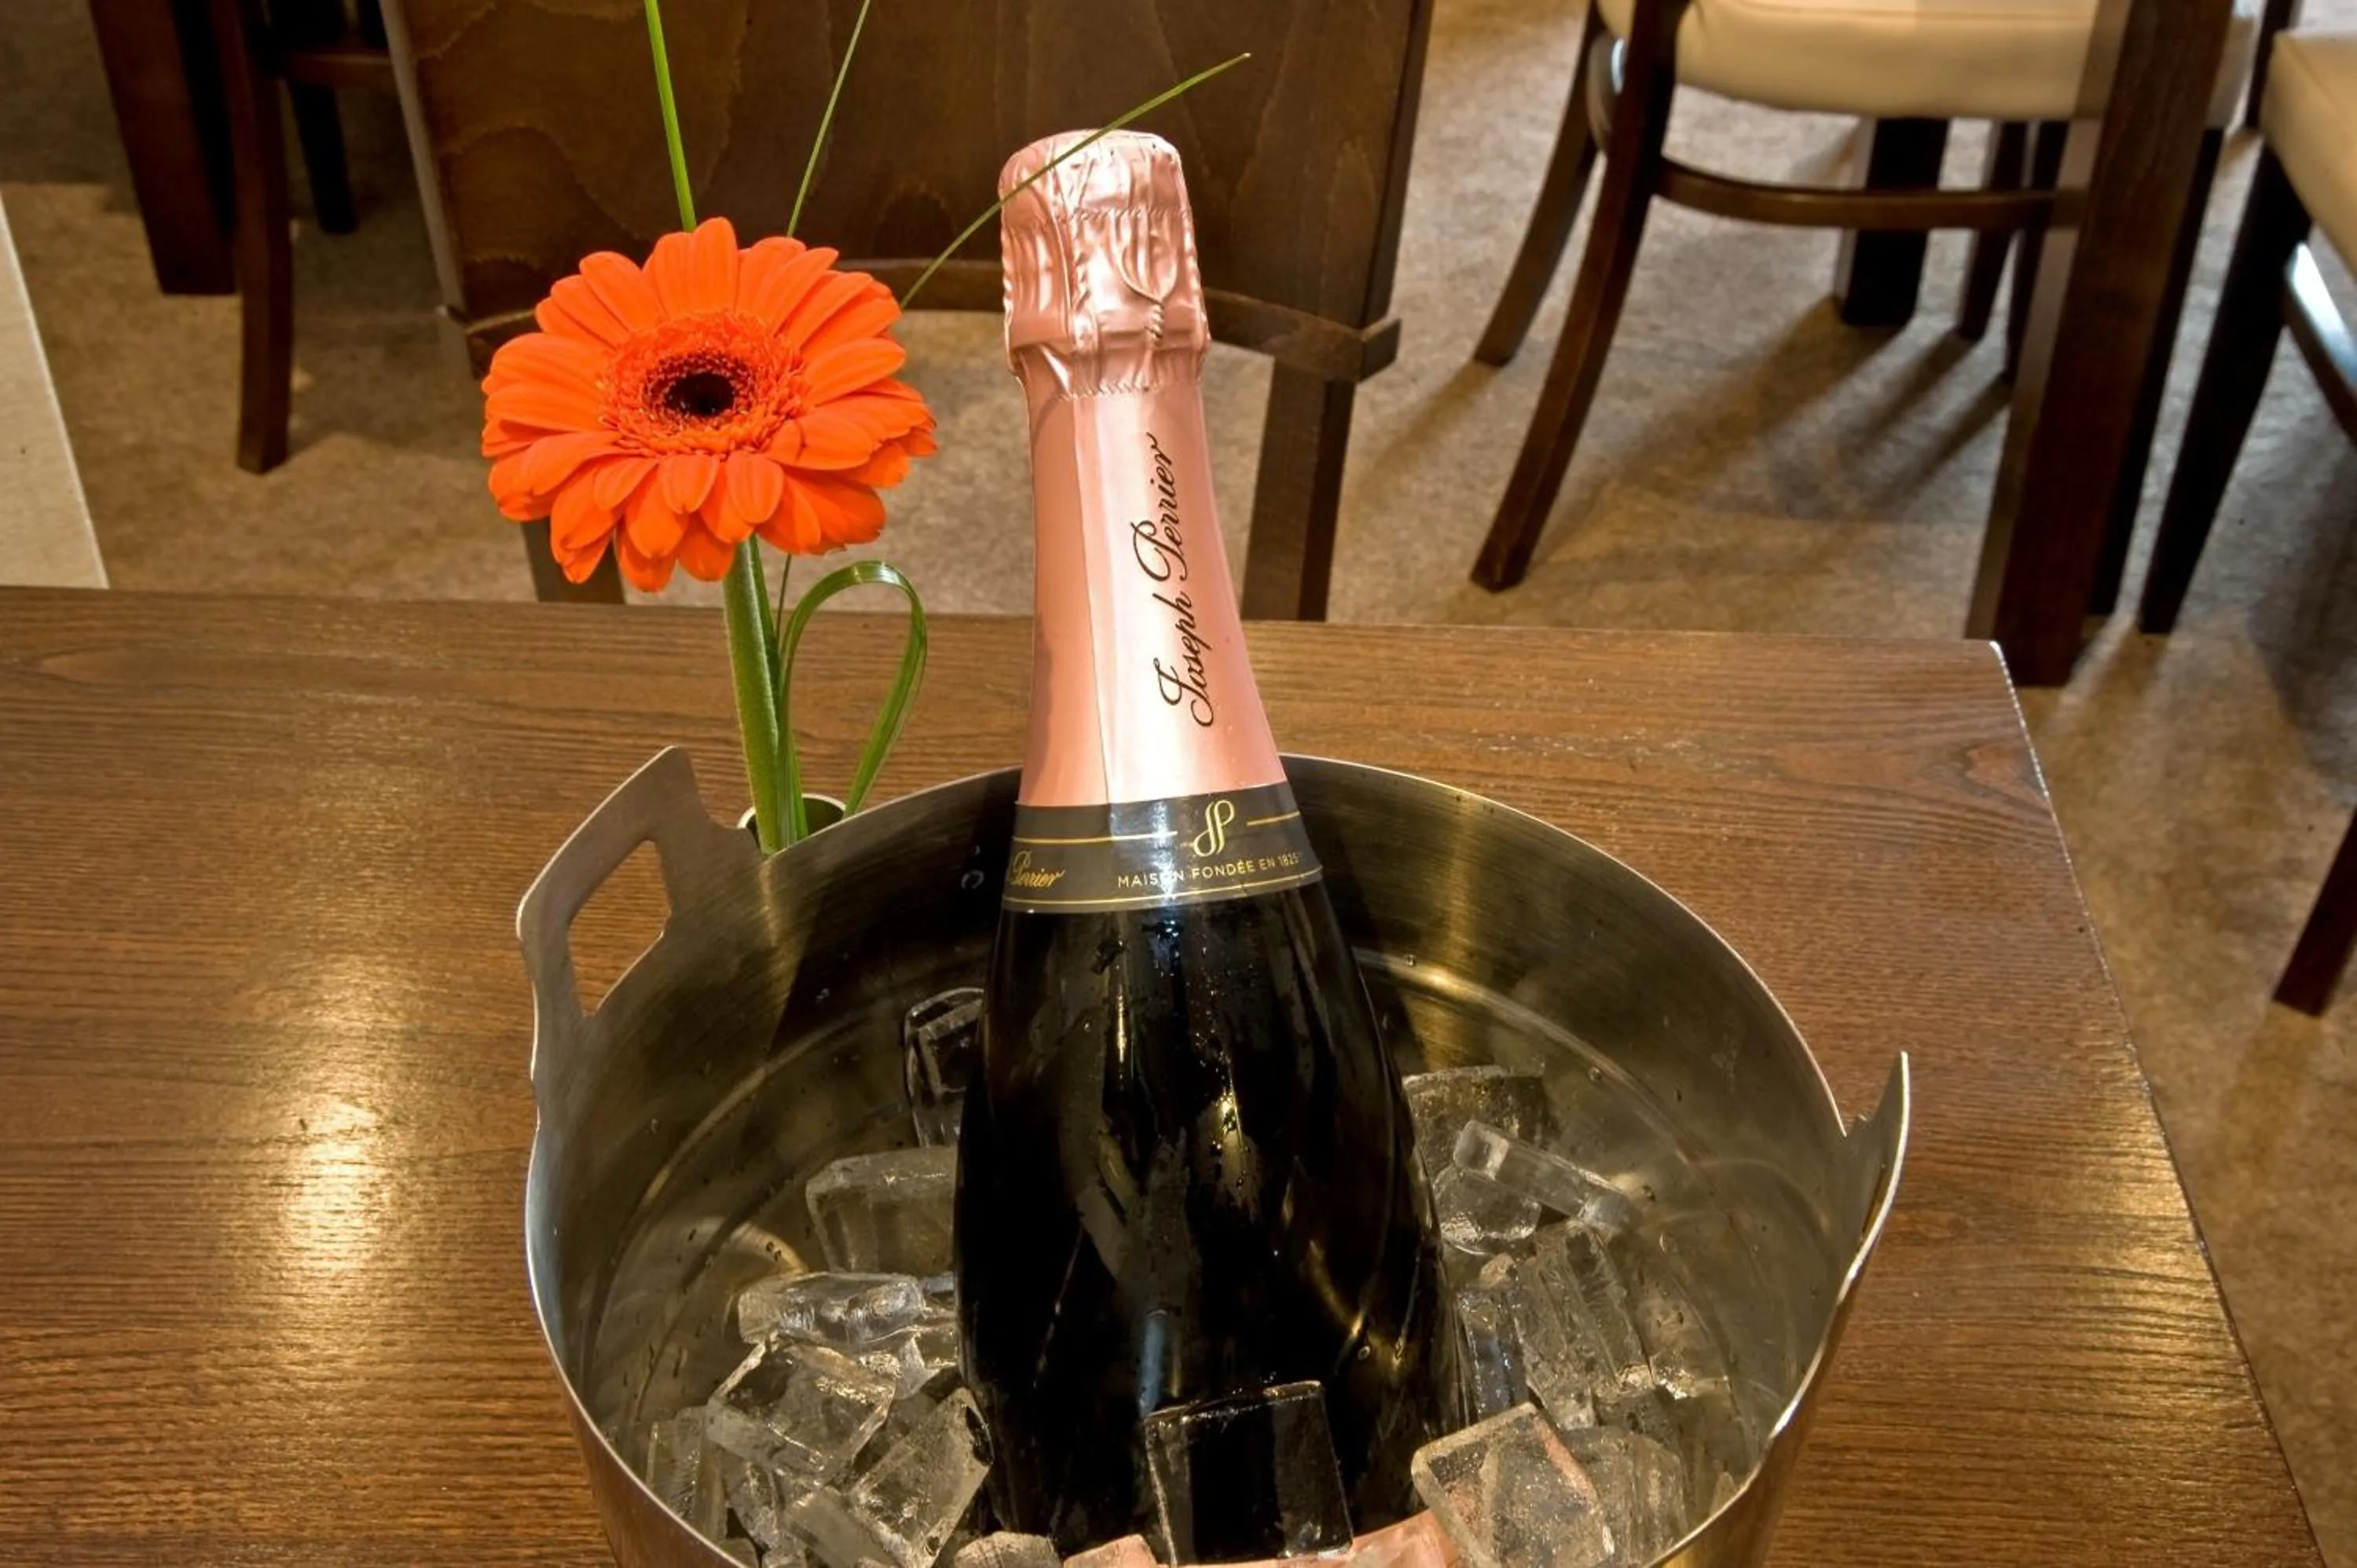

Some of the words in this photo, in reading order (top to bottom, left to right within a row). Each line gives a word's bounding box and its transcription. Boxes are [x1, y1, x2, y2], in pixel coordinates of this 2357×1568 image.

[1130, 431, 1188, 581] Perrier
[1152, 591, 1214, 727] Joseph
[1117, 870, 1184, 888] MAISN
[1190, 859, 1256, 880] FONDÉE
[1258, 855, 1275, 871] EN
